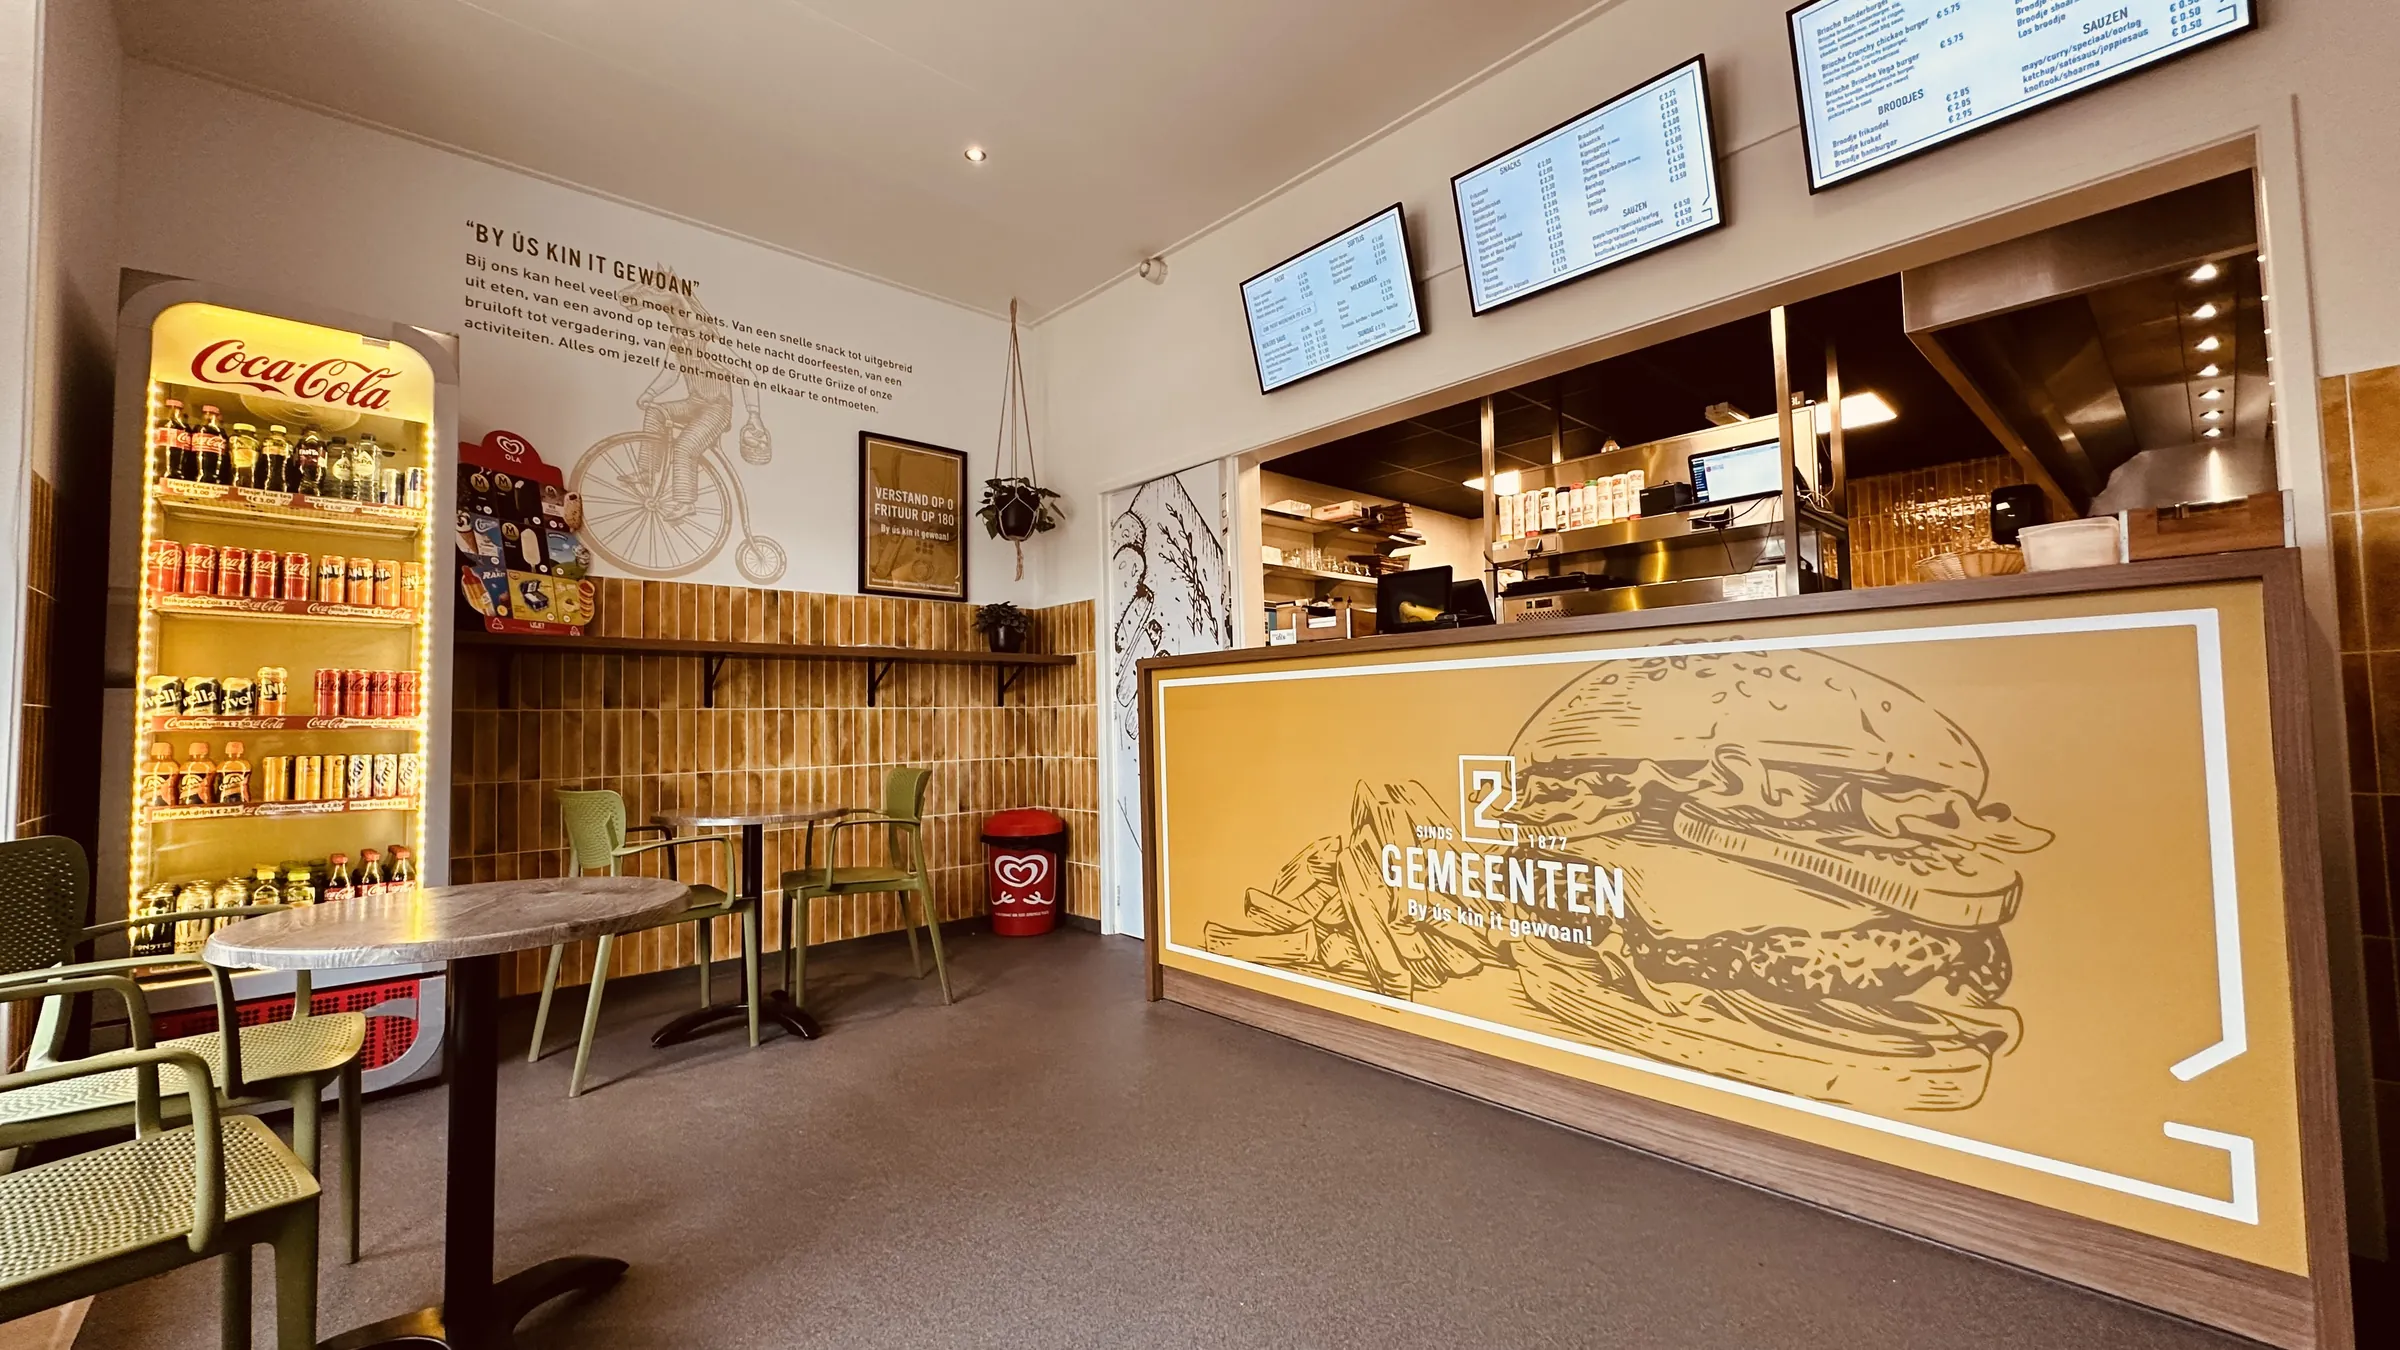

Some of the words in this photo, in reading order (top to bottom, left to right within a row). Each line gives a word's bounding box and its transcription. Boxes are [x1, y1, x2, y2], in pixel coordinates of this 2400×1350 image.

[1943, 2, 1961, 16] 5.75
[2017, 9, 2048, 27] Broodje
[2083, 7, 2129, 35] SAUZEN
[2171, 15, 2177, 24] €
[2180, 6, 2201, 21] 0.50
[1817, 20, 1842, 36] Brioche
[1946, 32, 1964, 46] 5.75
[2018, 28, 2033, 38] Los
[2034, 14, 2066, 31] broodje
[2172, 28, 2178, 37] €
[2181, 18, 2202, 34] 0.50
[1821, 55, 1846, 71] Brioche
[1847, 43, 1875, 60] Crunchy
[1876, 29, 1903, 46] chicken
[1904, 17, 1929, 34] burger
[2021, 18, 2142, 73] mayo/curry/speciaal/oorlog
[1825, 83, 1850, 99] Brioche
[1851, 72, 1877, 88] Brioche
[1877, 64, 1895, 77] Vega
[1896, 53, 1920, 70] burger
[2023, 58, 2100, 95] knoflook/shoarma
[1877, 89, 1924, 115] BROODJES
[1956, 108, 1973, 121] 2.95
[1832, 134, 1857, 148] Broodje
[1858, 119, 1889, 137] frikandel
[1833, 143, 1859, 158] Broodje
[1860, 133, 1882, 148] kroket
[1835, 153, 1860, 168] Broodje
[1861, 139, 1898, 157] hamburger
[1500, 159, 1521, 176] SNACKS
[1622, 201, 1648, 218] SAUZEN
[512, 230, 539, 257] ÚS
[547, 242, 580, 268] KIN
[589, 253, 606, 274] IT
[466, 253, 486, 271] Bij
[491, 262, 518, 276] ons
[523, 267, 550, 284] kan
[555, 276, 586, 293] heel
[589, 286, 618, 301] veel
[622, 294, 638, 306] en
[642, 299, 675, 315] moet
[678, 307, 692, 318] er
[695, 312, 729, 328] niets.
[732, 320, 753, 334] Van
[756, 328, 776, 339] een
[780, 334, 812, 348] snelle
[815, 343, 846, 357] snack
[848, 350, 862, 360] tot
[864, 355, 912, 373] uitgebreid
[466, 276, 486, 289] uit
[533, 292, 558, 306] van
[563, 300, 589, 313] een
[593, 307, 633, 323] avond
[638, 318, 653, 329] op
[657, 321, 695, 338] terras
[699, 330, 716, 343] tot
[719, 336, 733, 347] de
[737, 339, 761, 353] hele
[764, 347, 795, 362] nacht
[865, 371, 882, 382] van
[884, 376, 902, 387] een
[465, 295, 523, 319] bruiloft
[527, 309, 548, 324] tot
[643, 337, 666, 350] van
[670, 343, 693, 356] een
[697, 348, 753, 370] boottocht
[755, 363, 769, 375] op
[772, 366, 786, 376] de
[788, 368, 823, 385] Grutte
[857, 385, 867, 395] of
[870, 389, 893, 401] onze
[464, 319, 554, 345] activiteiten.
[558, 337, 595, 354] Alles
[598, 347, 620, 359] om
[623, 351, 661, 367] jezelf
[663, 360, 676, 371] te
[680, 364, 750, 387] ont-moeten
[753, 379, 767, 390] en
[770, 383, 805, 397] elkaar
[808, 391, 819, 401] te
[821, 395, 879, 414] ontmoeten.
[505, 454, 522, 464] OLA
[874, 486, 929, 506] VERSTAND
[932, 496, 945, 509] OP
[948, 498, 954, 511] 0
[874, 503, 919, 521] FRITUUR
[921, 510, 935, 523] OP
[937, 513, 955, 526] 180
[880, 524, 890, 535] By
[902, 526, 913, 537] kin
[914, 528, 920, 538] it
[921, 531, 949, 541] gewoan!
[1473, 770, 1503, 828] 2
[1416, 825, 1453, 841] SINDS
[1528, 834, 1568, 851] 1877
[1381, 843, 1625, 919] GEMEENTEN
[1407, 898, 1428, 922] By
[1432, 903, 1451, 922] ús
[1457, 907, 1484, 929] kin
[1490, 911, 1504, 931] it
[1509, 918, 1593, 945] gewoan!
